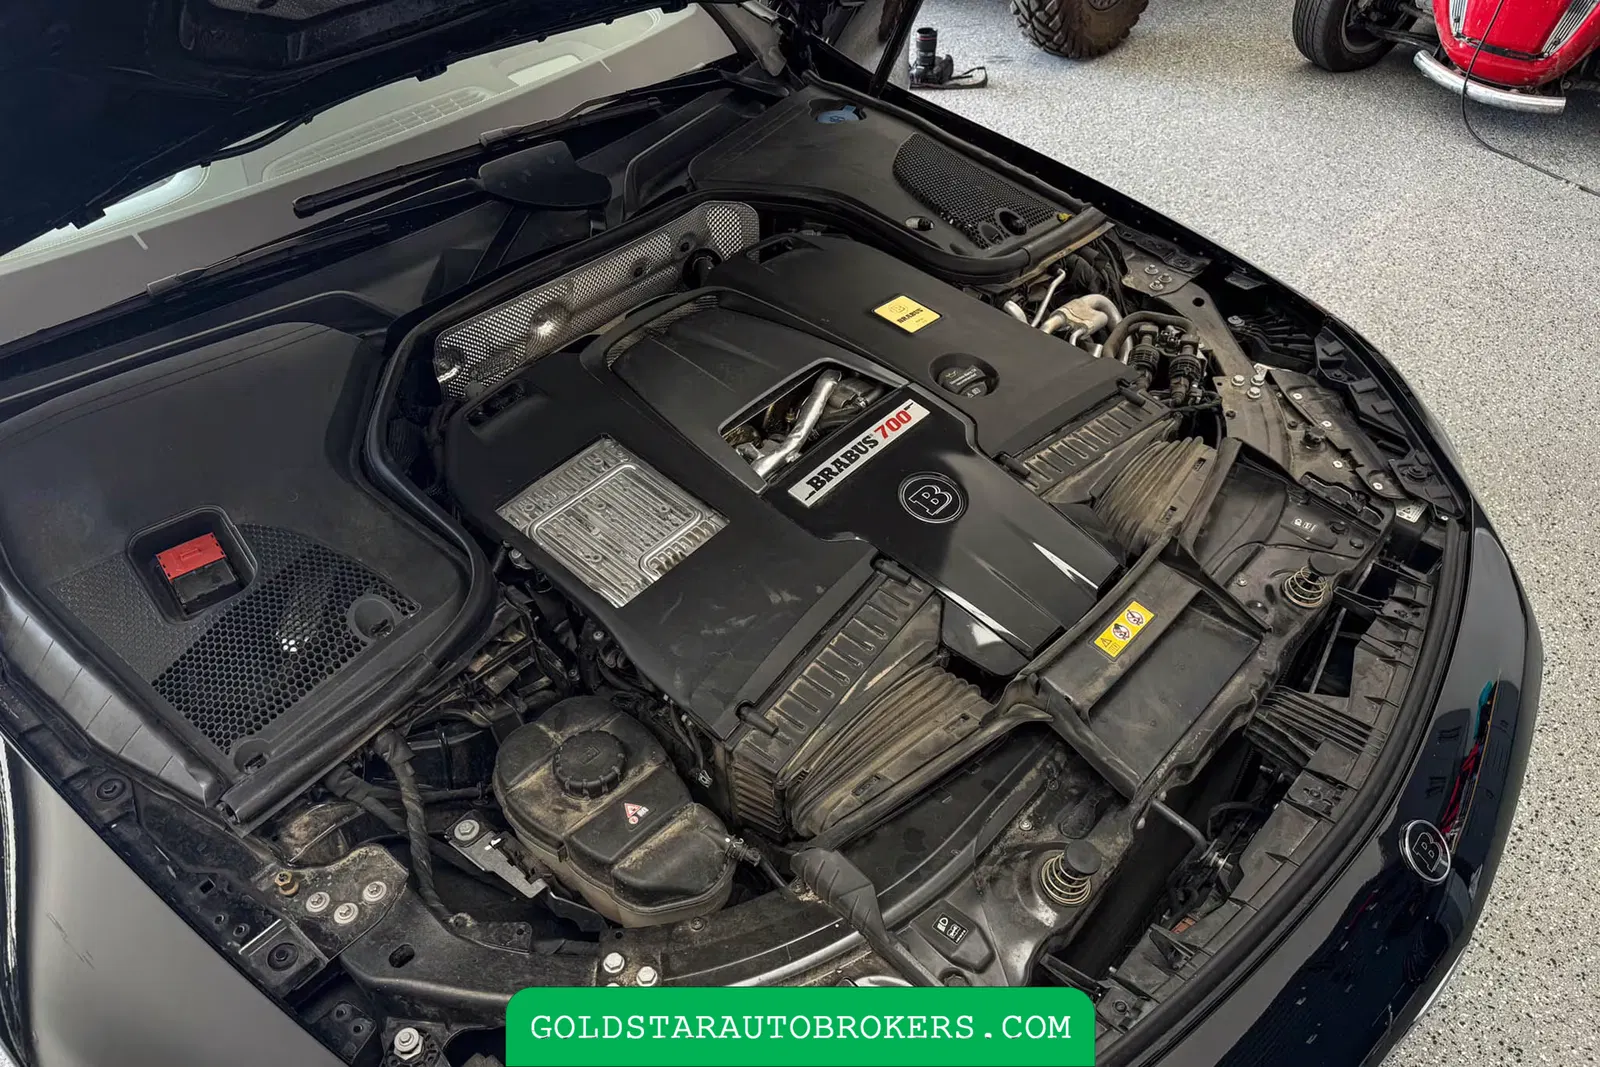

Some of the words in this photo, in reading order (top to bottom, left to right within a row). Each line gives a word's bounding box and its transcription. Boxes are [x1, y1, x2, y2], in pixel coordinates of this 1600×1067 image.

[805, 433, 879, 495] BRABUS
[873, 409, 913, 440] 700
[908, 484, 952, 516] B
[1412, 832, 1443, 873] B
